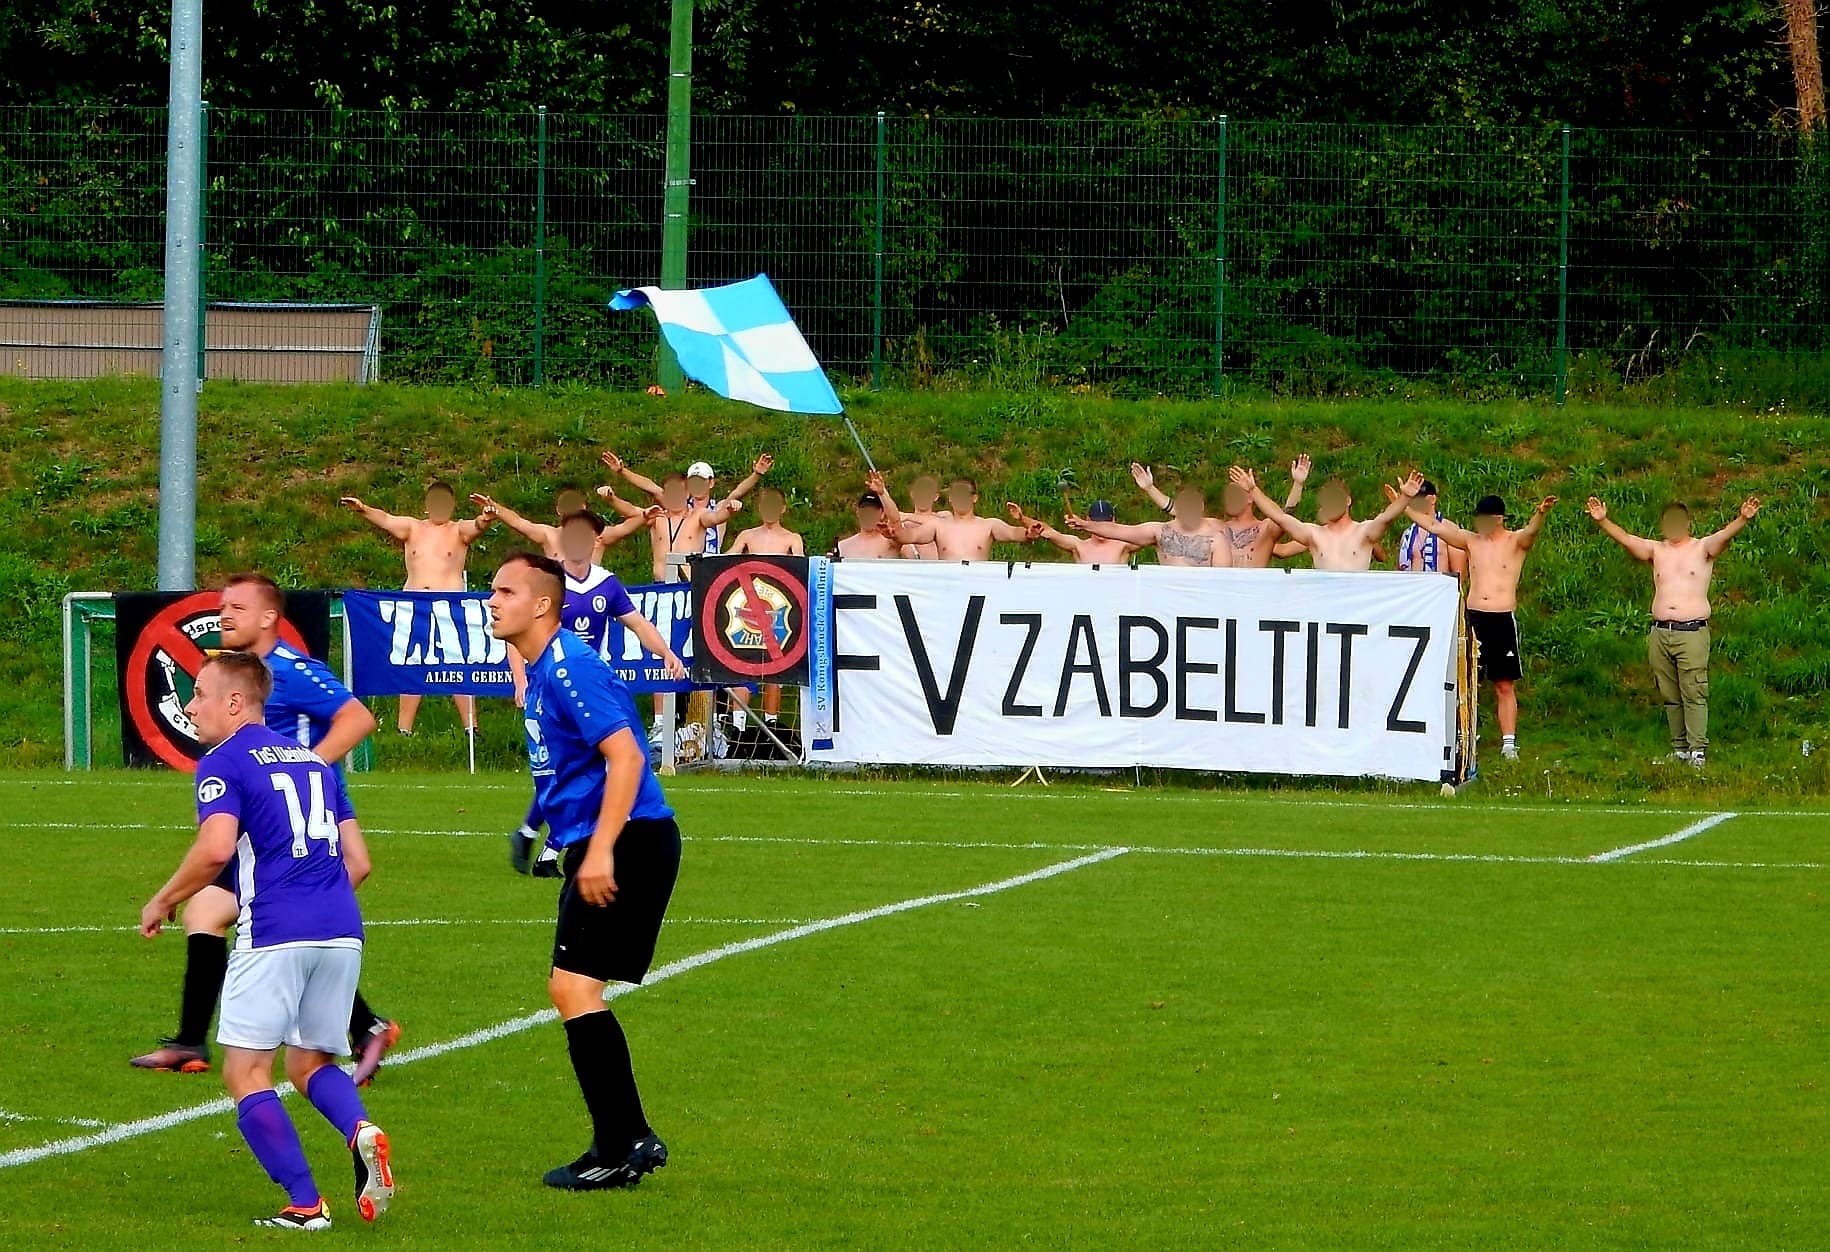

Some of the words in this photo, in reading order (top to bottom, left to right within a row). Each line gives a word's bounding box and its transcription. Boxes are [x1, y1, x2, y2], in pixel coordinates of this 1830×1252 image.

[425, 670, 465, 683] ALLES
[471, 670, 513, 683] GEBEN
[615, 669, 636, 681] ND
[833, 594, 986, 735] FV
[999, 612, 1431, 734] ZABELTITZ
[817, 696, 826, 711] SV
[270, 771, 339, 858] 14
